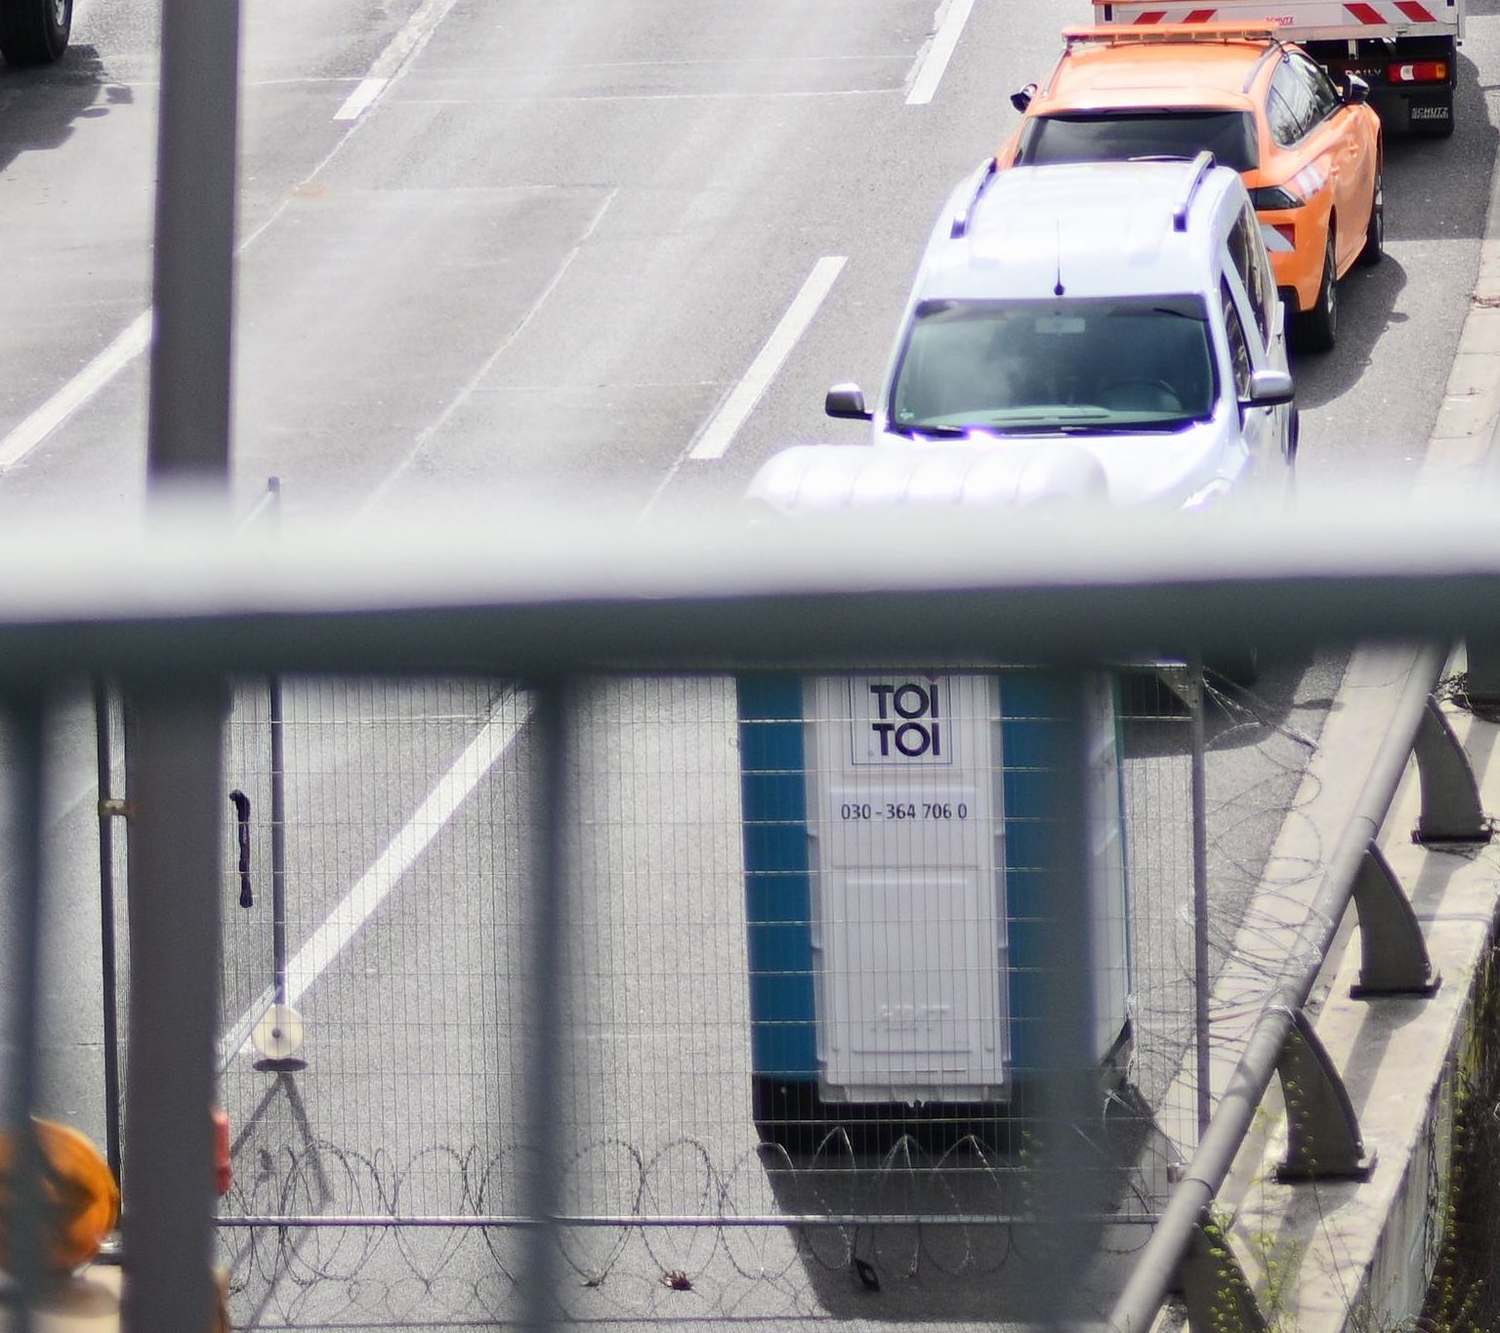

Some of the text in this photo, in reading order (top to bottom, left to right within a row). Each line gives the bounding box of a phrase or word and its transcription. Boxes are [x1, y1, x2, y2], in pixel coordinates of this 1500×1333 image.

[870, 684, 940, 720] TOI
[872, 722, 941, 757] TOI
[841, 803, 871, 820] 030
[886, 803, 915, 819] 364
[923, 803, 952, 819] 706
[958, 803, 968, 820] 0
